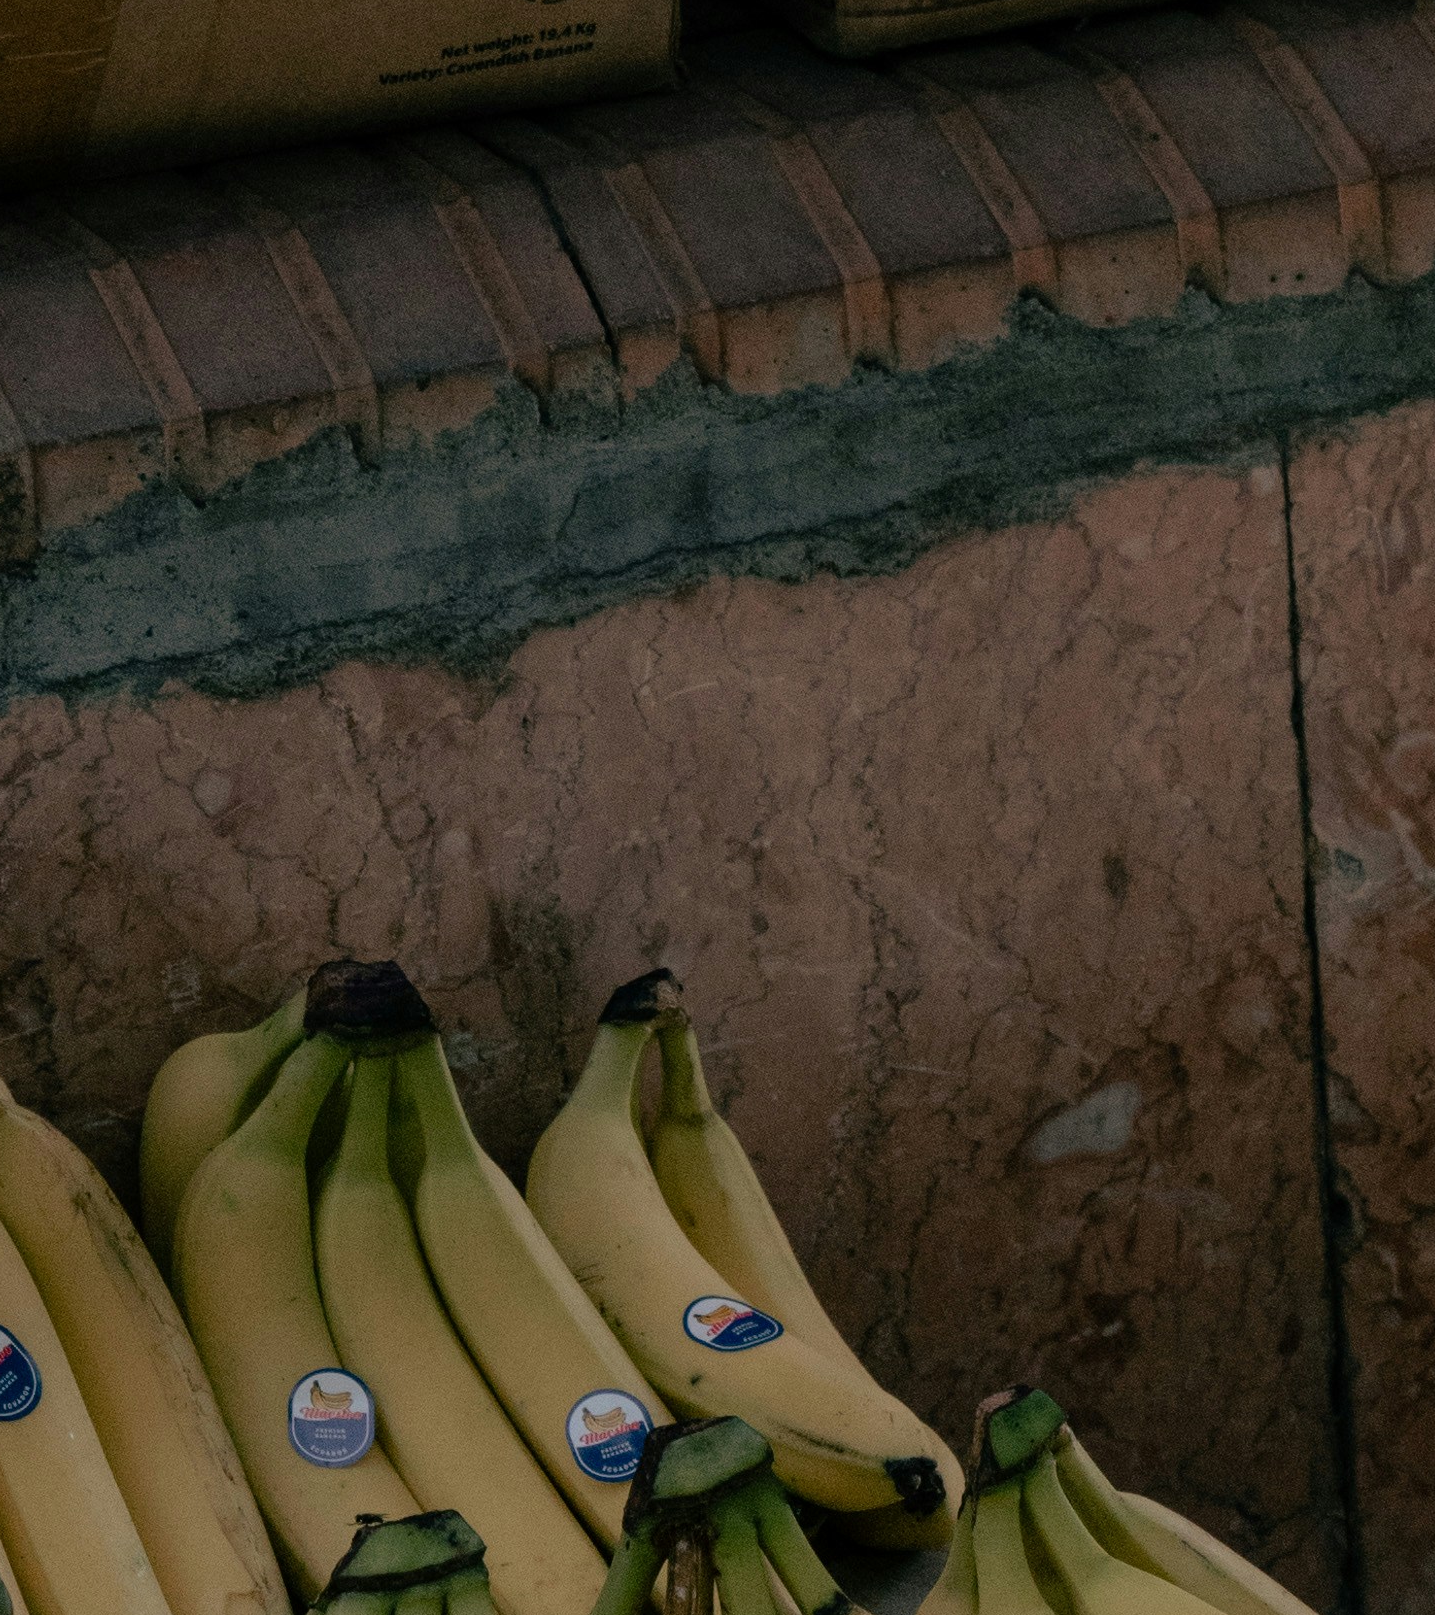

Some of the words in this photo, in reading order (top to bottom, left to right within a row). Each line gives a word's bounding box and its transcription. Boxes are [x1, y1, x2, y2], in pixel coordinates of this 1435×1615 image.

[378, 68, 443, 86] Variety:
[445, 50, 531, 76] Cavendish
[532, 40, 595, 62] Banana
[441, 45, 470, 60] Net
[473, 32, 535, 54] weight:
